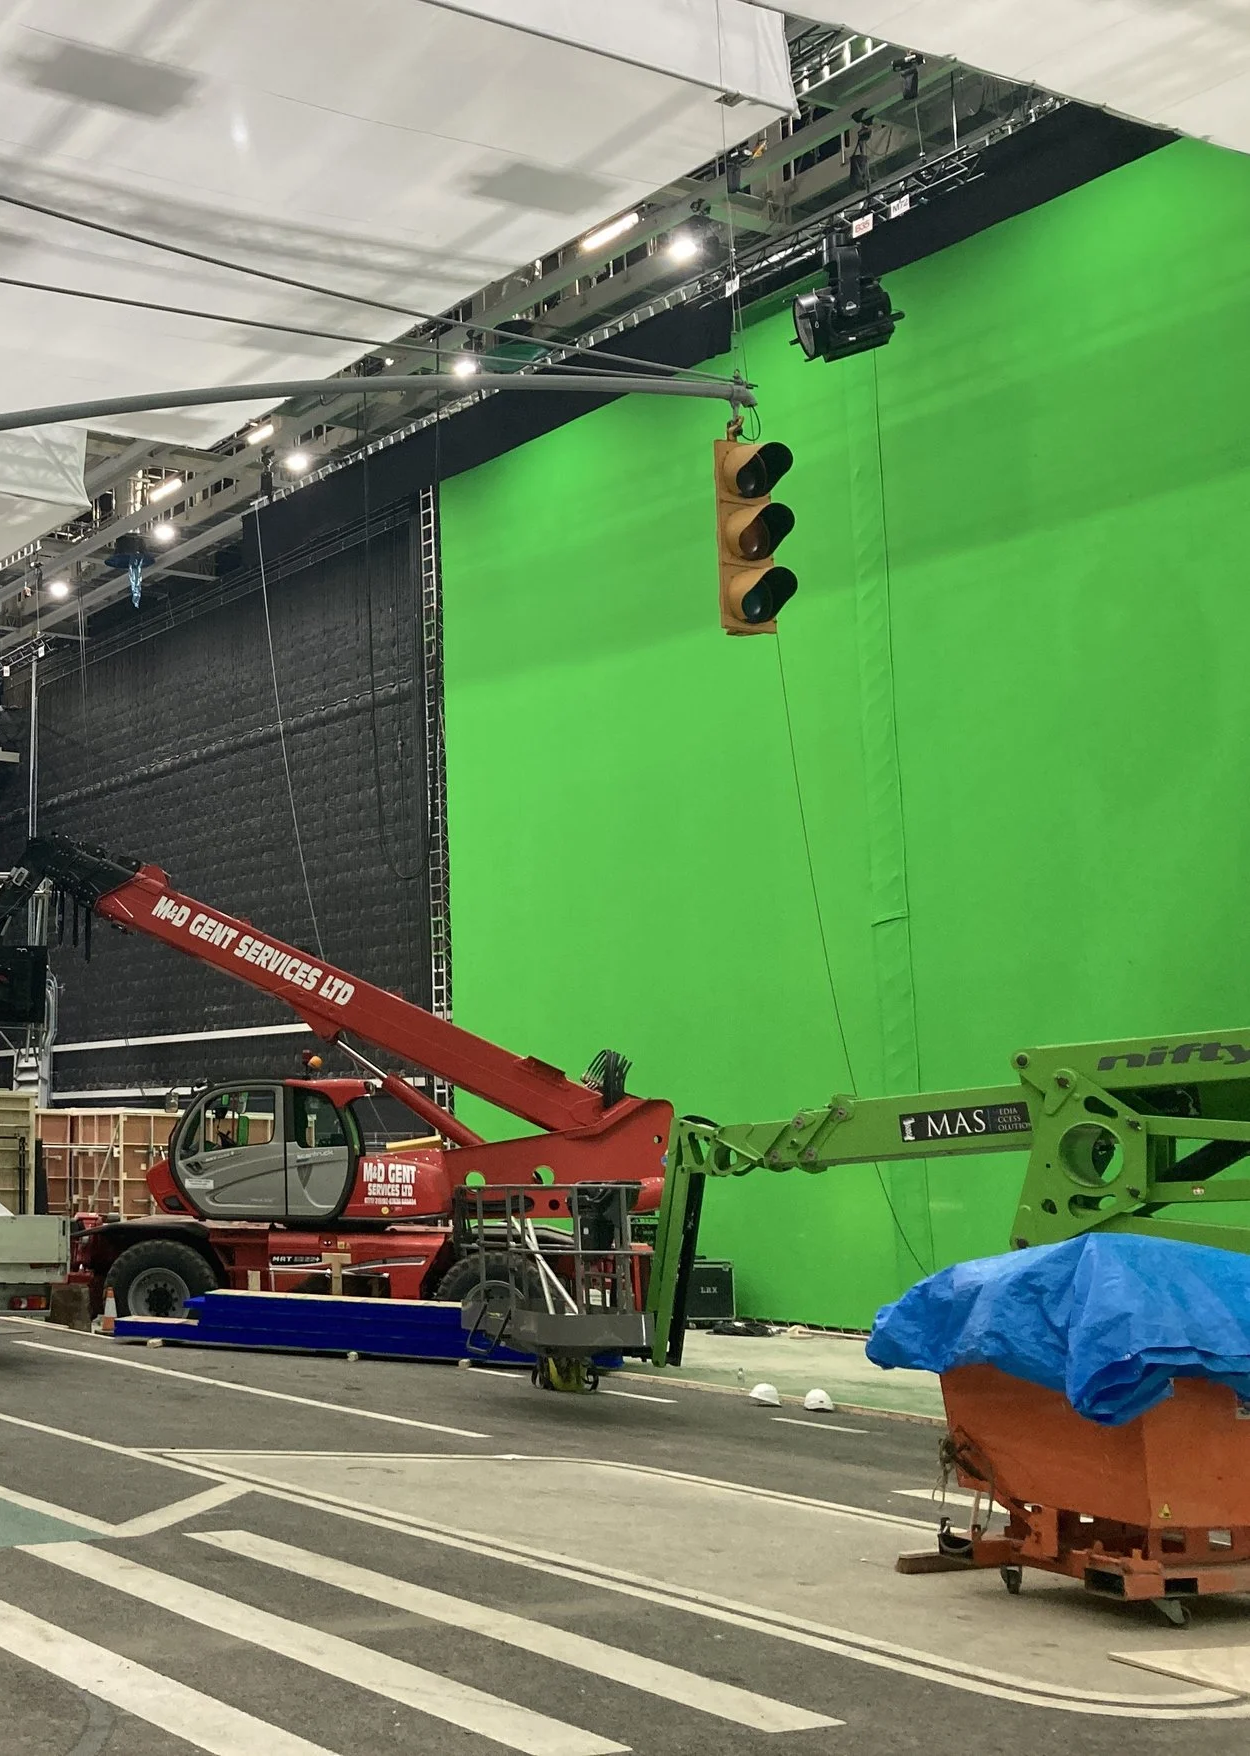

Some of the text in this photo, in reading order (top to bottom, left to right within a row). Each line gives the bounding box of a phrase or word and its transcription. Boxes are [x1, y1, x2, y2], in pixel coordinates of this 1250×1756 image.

[151, 896, 355, 1006] M&D GENT SERVICES LTD
[927, 1109, 986, 1137] MAS
[363, 1162, 416, 1183] M&D GENT
[367, 1183, 413, 1196] SERVICES LTD
